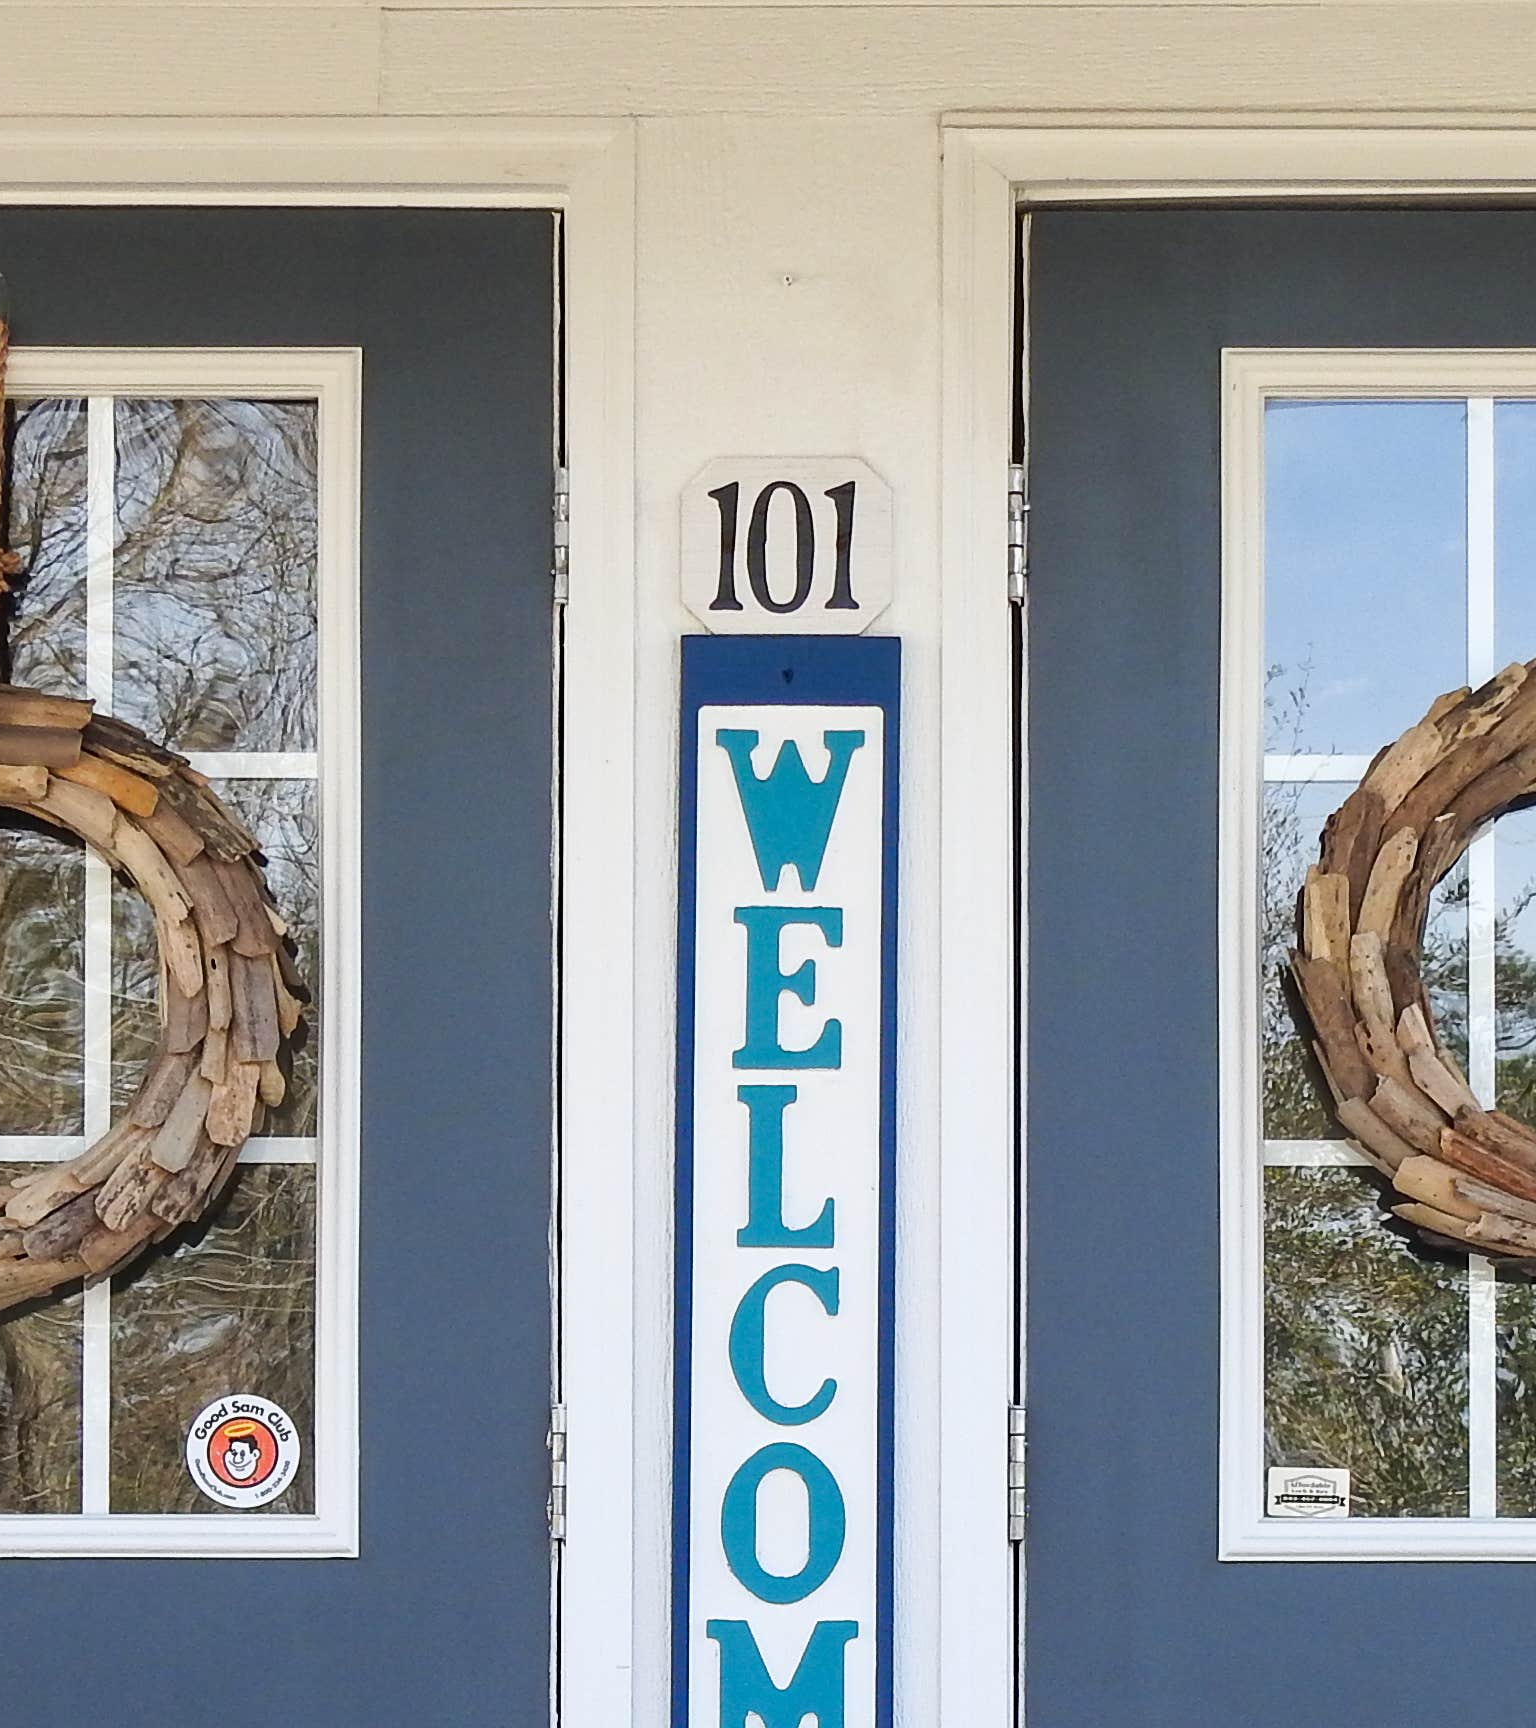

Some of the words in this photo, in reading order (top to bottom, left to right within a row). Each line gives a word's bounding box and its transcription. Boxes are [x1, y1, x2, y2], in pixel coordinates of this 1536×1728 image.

[707, 480, 861, 614] 101
[194, 1403, 229, 1440] Good
[231, 1400, 265, 1416] Sam
[267, 1412, 292, 1442] Club
